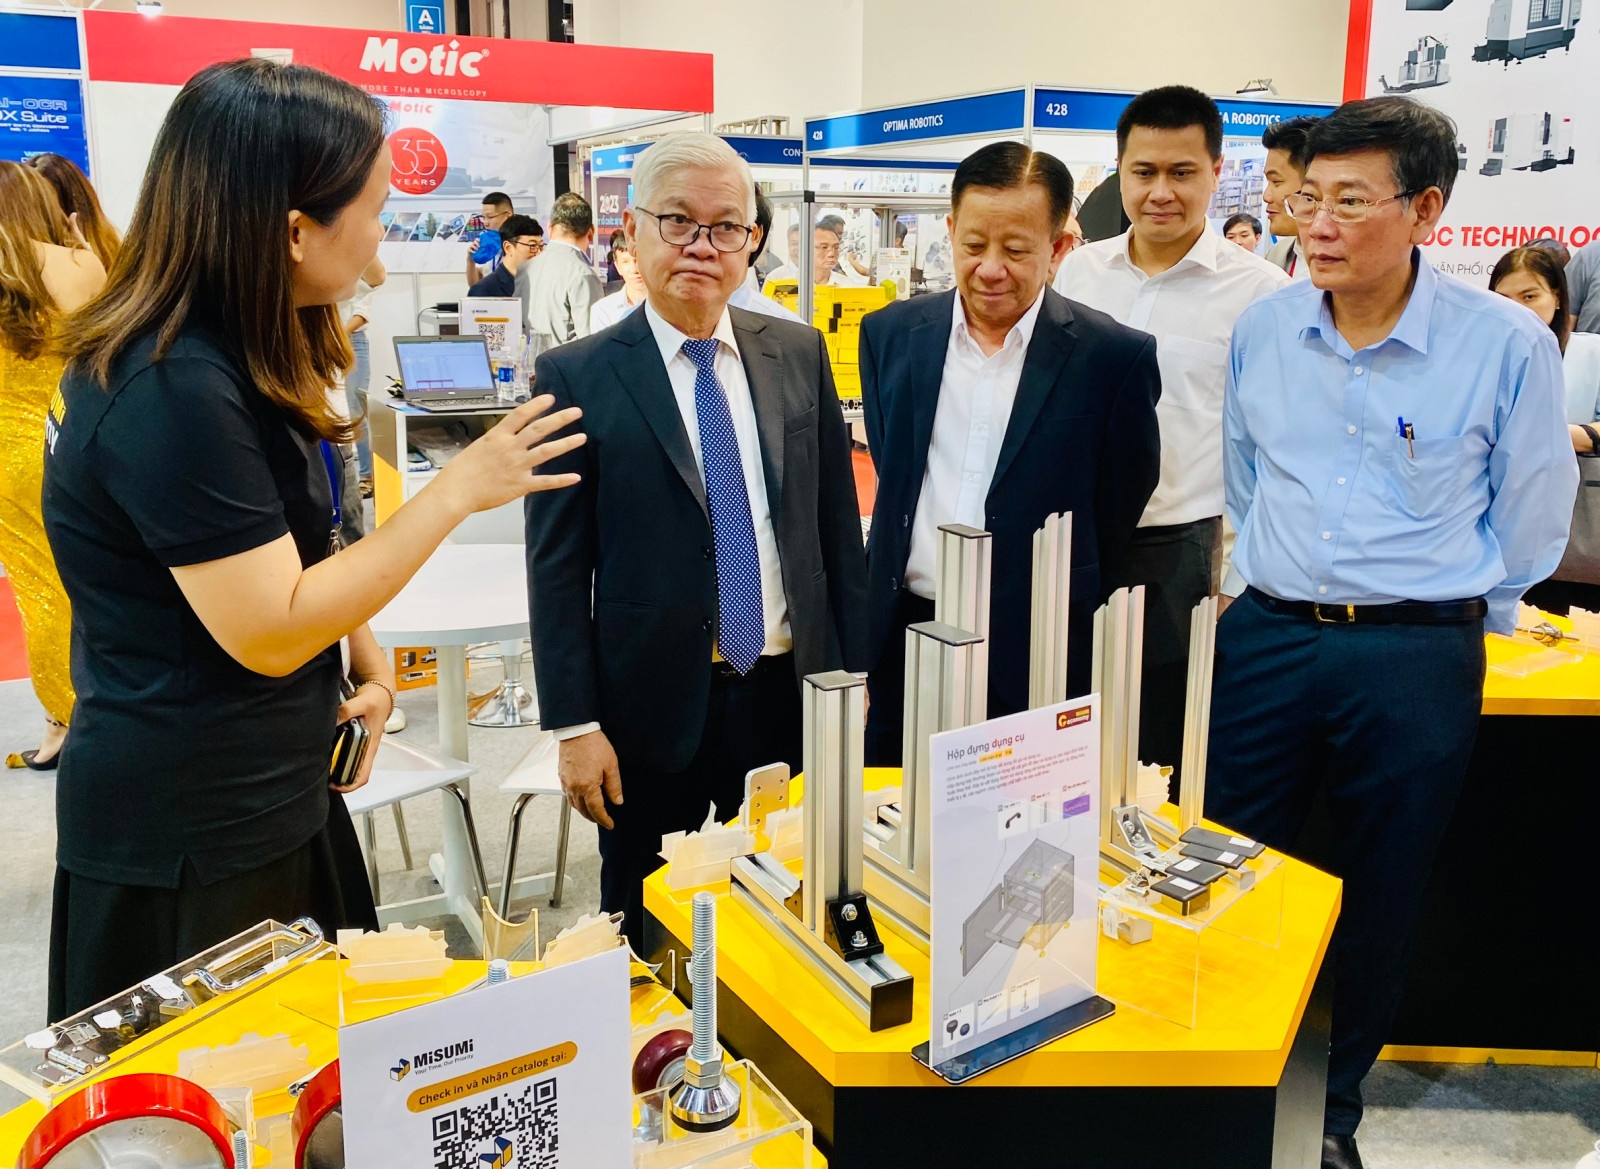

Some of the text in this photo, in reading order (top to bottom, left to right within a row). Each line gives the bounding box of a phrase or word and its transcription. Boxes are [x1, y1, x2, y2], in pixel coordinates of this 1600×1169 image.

[418, 10, 434, 25] A
[361, 84, 487, 97] MORE THAN MICROSCOPY
[0, 97, 67, 111] I-OCR
[389, 100, 433, 114] Motic
[1045, 102, 1068, 116] 428
[20, 110, 67, 123] Suite
[883, 114, 944, 133] OPTIMA ROBOTICS
[1231, 112, 1281, 126] ROBOTICS
[812, 130, 824, 141] 428
[395, 178, 436, 187] YEARS
[599, 193, 619, 214] 2023
[1457, 260, 1484, 275] PHỐI
[947, 748, 965, 761] Hộp
[992, 737, 1013, 749] dụng
[1015, 733, 1025, 743] cụ
[454, 1053, 474, 1064] Priority
[419, 1051, 568, 1106] Check in và Nhận Catalog tại:
